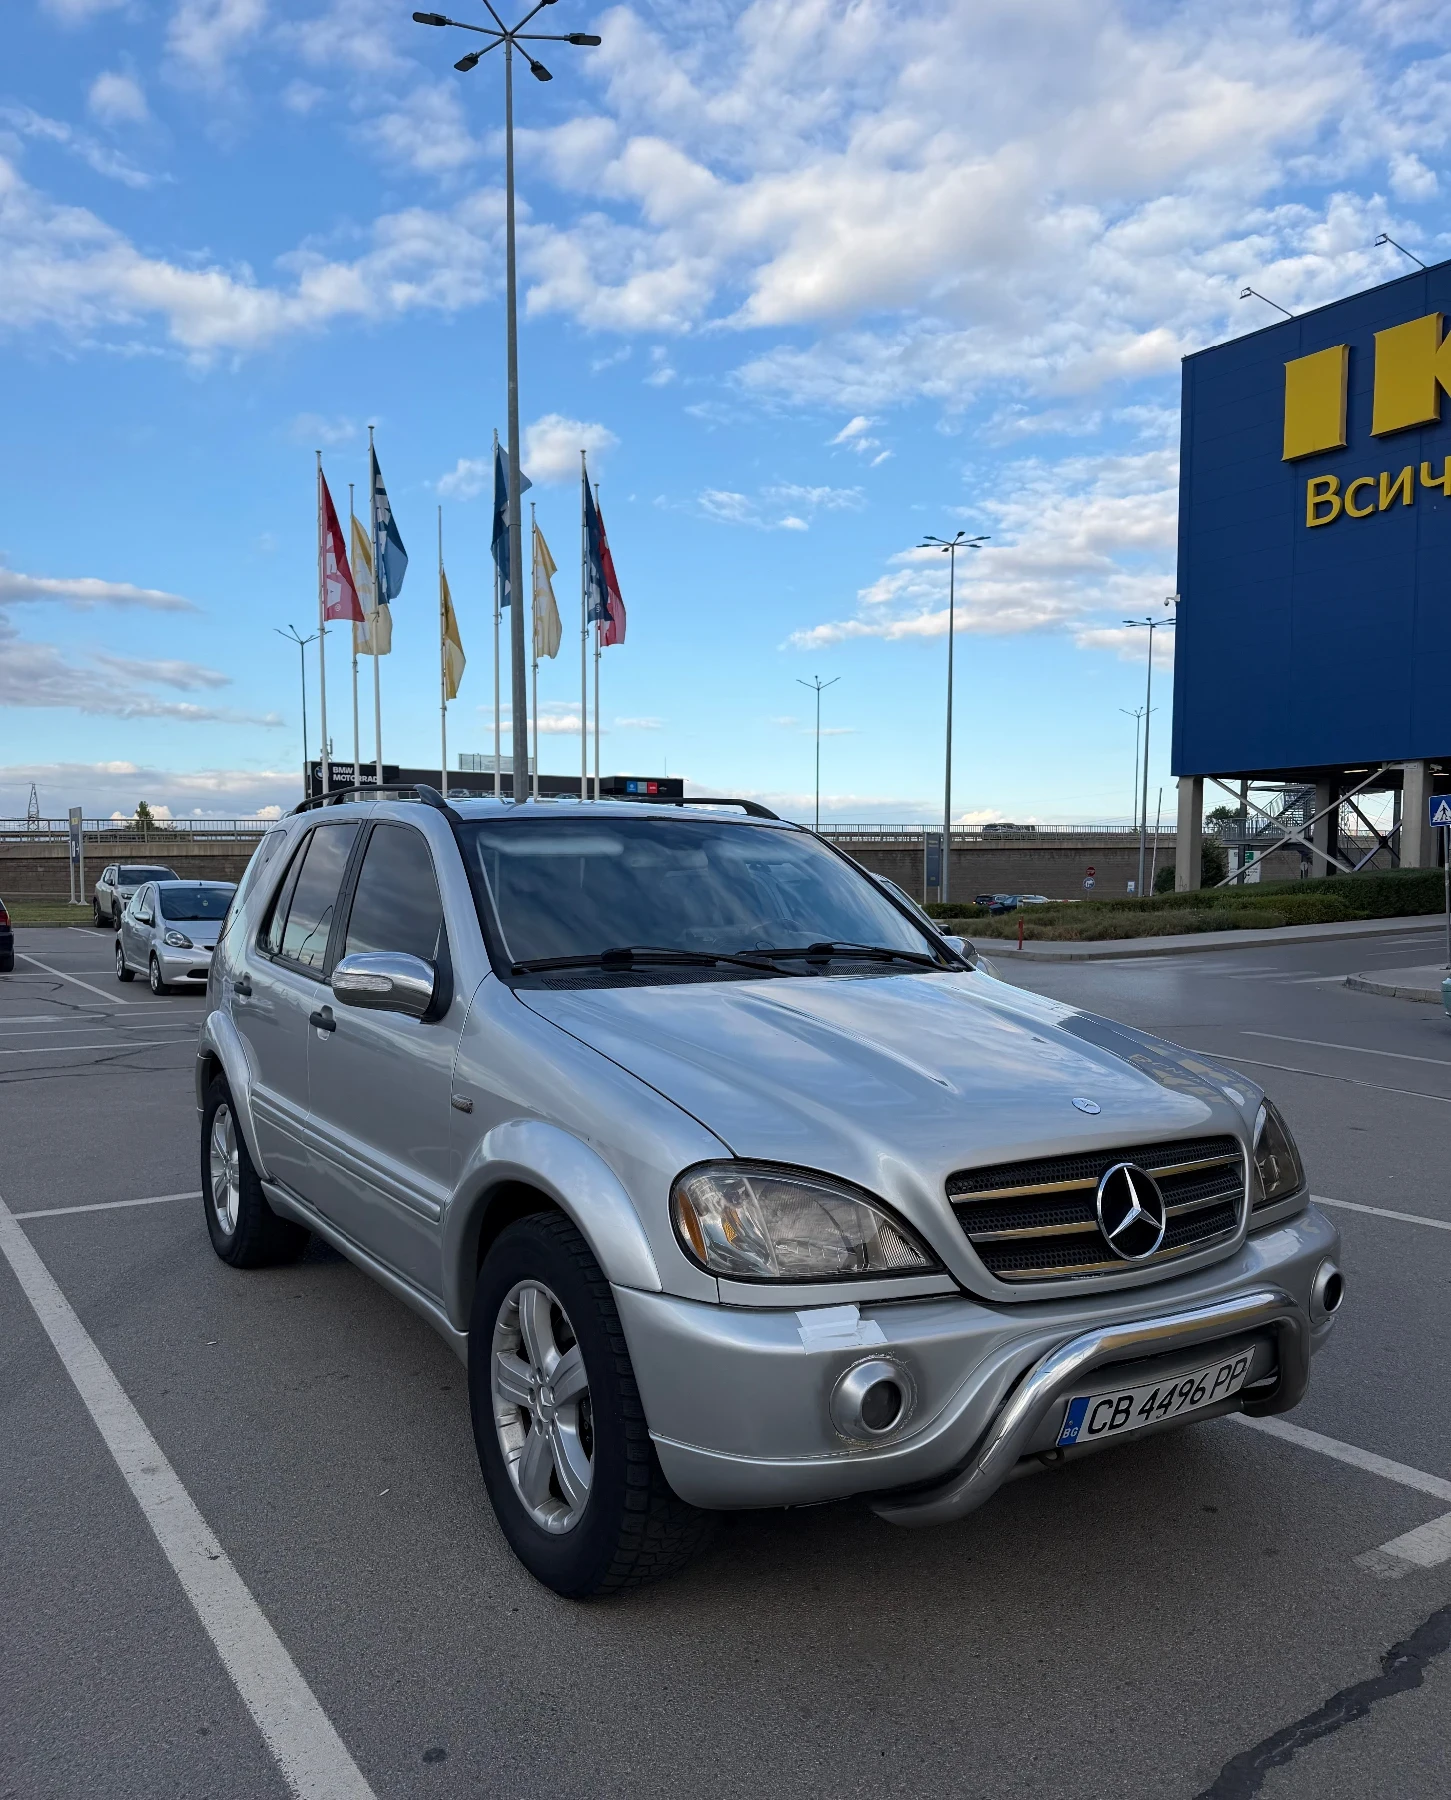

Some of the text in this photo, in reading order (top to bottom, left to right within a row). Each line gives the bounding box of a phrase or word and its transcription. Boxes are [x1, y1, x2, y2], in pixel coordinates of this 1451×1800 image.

[1305, 456, 1451, 528] Всич
[332, 766, 353, 774] BMW
[1087, 1356, 1248, 1435] CB 4496 PP
[1063, 1427, 1078, 1439] BG
